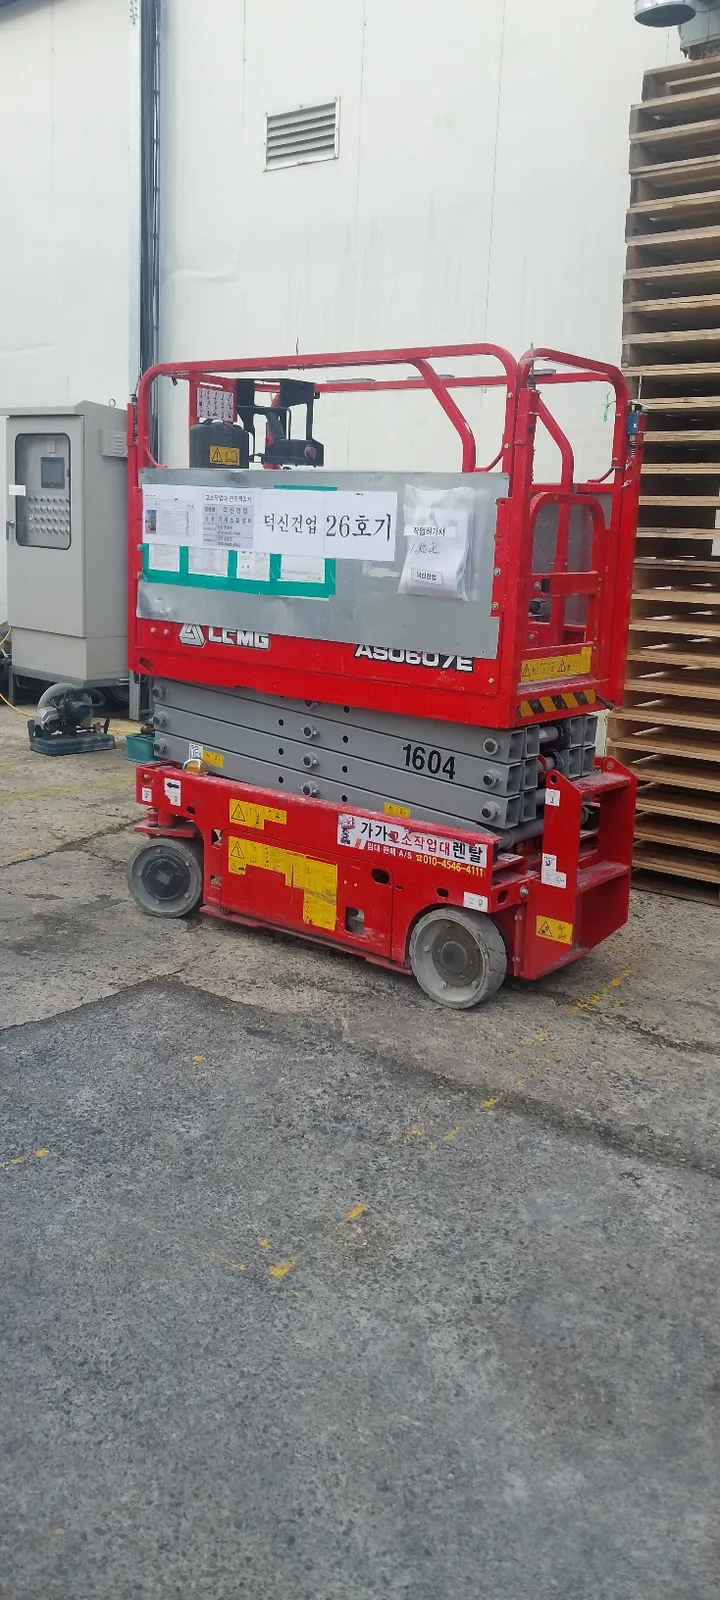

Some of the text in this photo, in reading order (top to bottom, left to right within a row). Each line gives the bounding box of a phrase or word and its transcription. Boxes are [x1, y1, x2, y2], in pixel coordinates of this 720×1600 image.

[263, 513, 317, 535] 덕신건업
[325, 513, 391, 542] 26호기
[413, 526, 446, 537] 작업허가서
[402, 743, 456, 780] 1604
